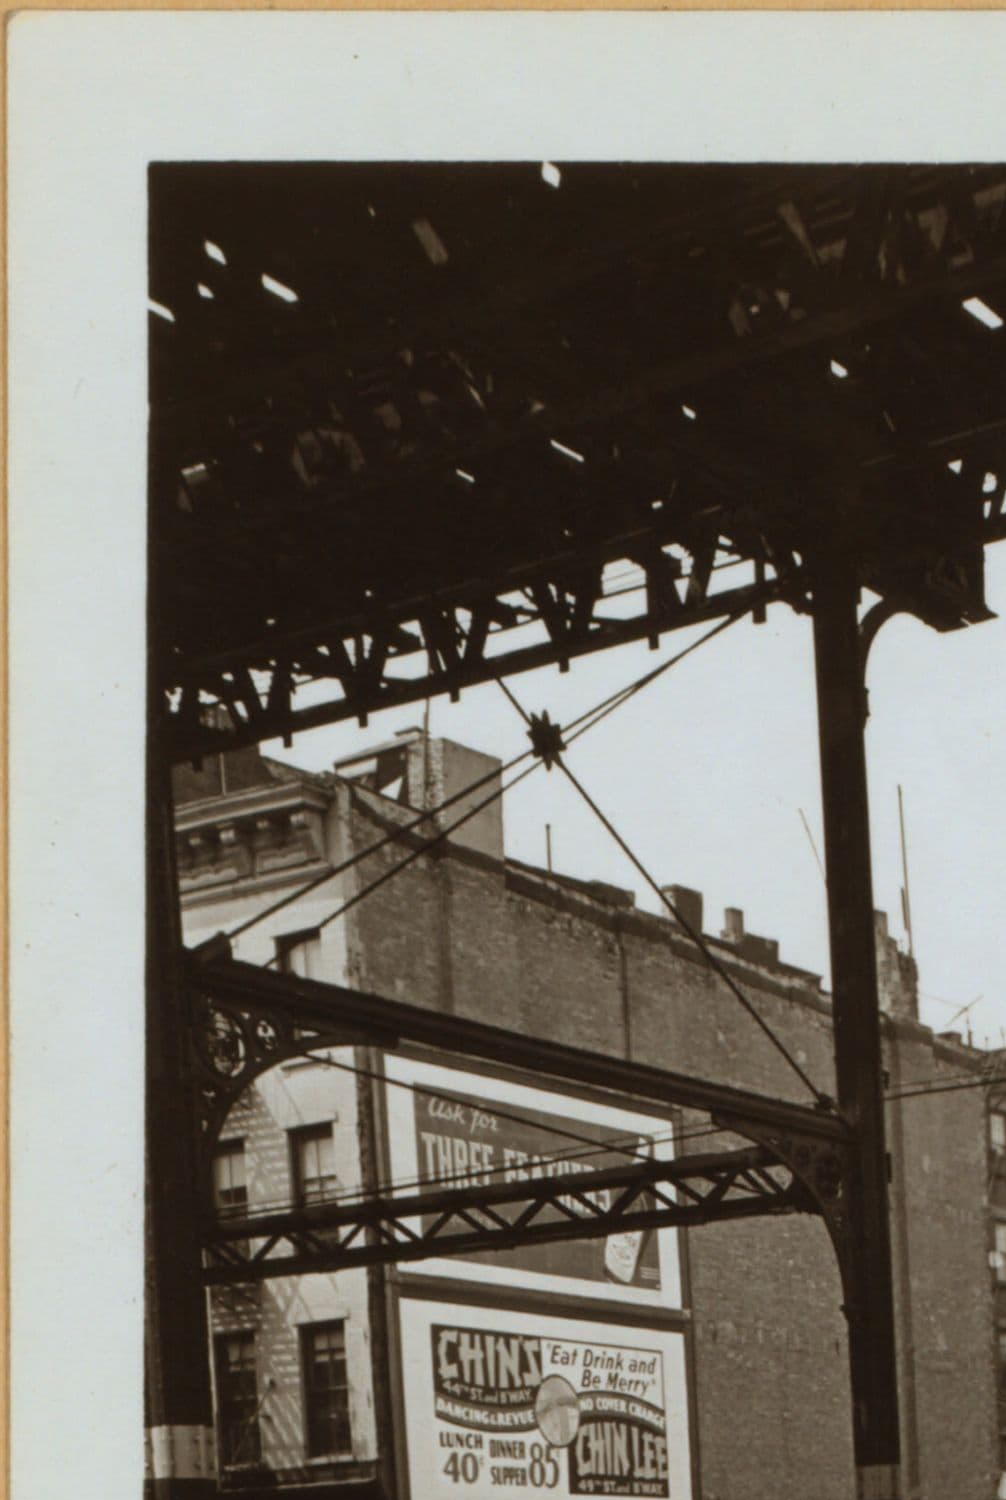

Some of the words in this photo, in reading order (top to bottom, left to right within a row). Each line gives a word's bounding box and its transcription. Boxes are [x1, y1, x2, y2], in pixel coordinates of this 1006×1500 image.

[427, 1096, 468, 1125] Ask
[469, 1106, 502, 1134] for
[421, 1132, 494, 1190] THREE
[437, 1330, 542, 1388] CHIN'S
[583, 1349, 625, 1371] Drink
[628, 1357, 657, 1375] and
[581, 1369, 602, 1389] Be
[436, 1397, 490, 1424] DANCING
[579, 1398, 595, 1411] NO
[595, 1398, 628, 1414] COVER
[439, 1431, 484, 1450] LUNCH
[489, 1439, 527, 1459] DINNER
[576, 1421, 631, 1477] CHIN
[631, 1425, 669, 1481] LEE
[490, 1466, 527, 1487] SUPPER
